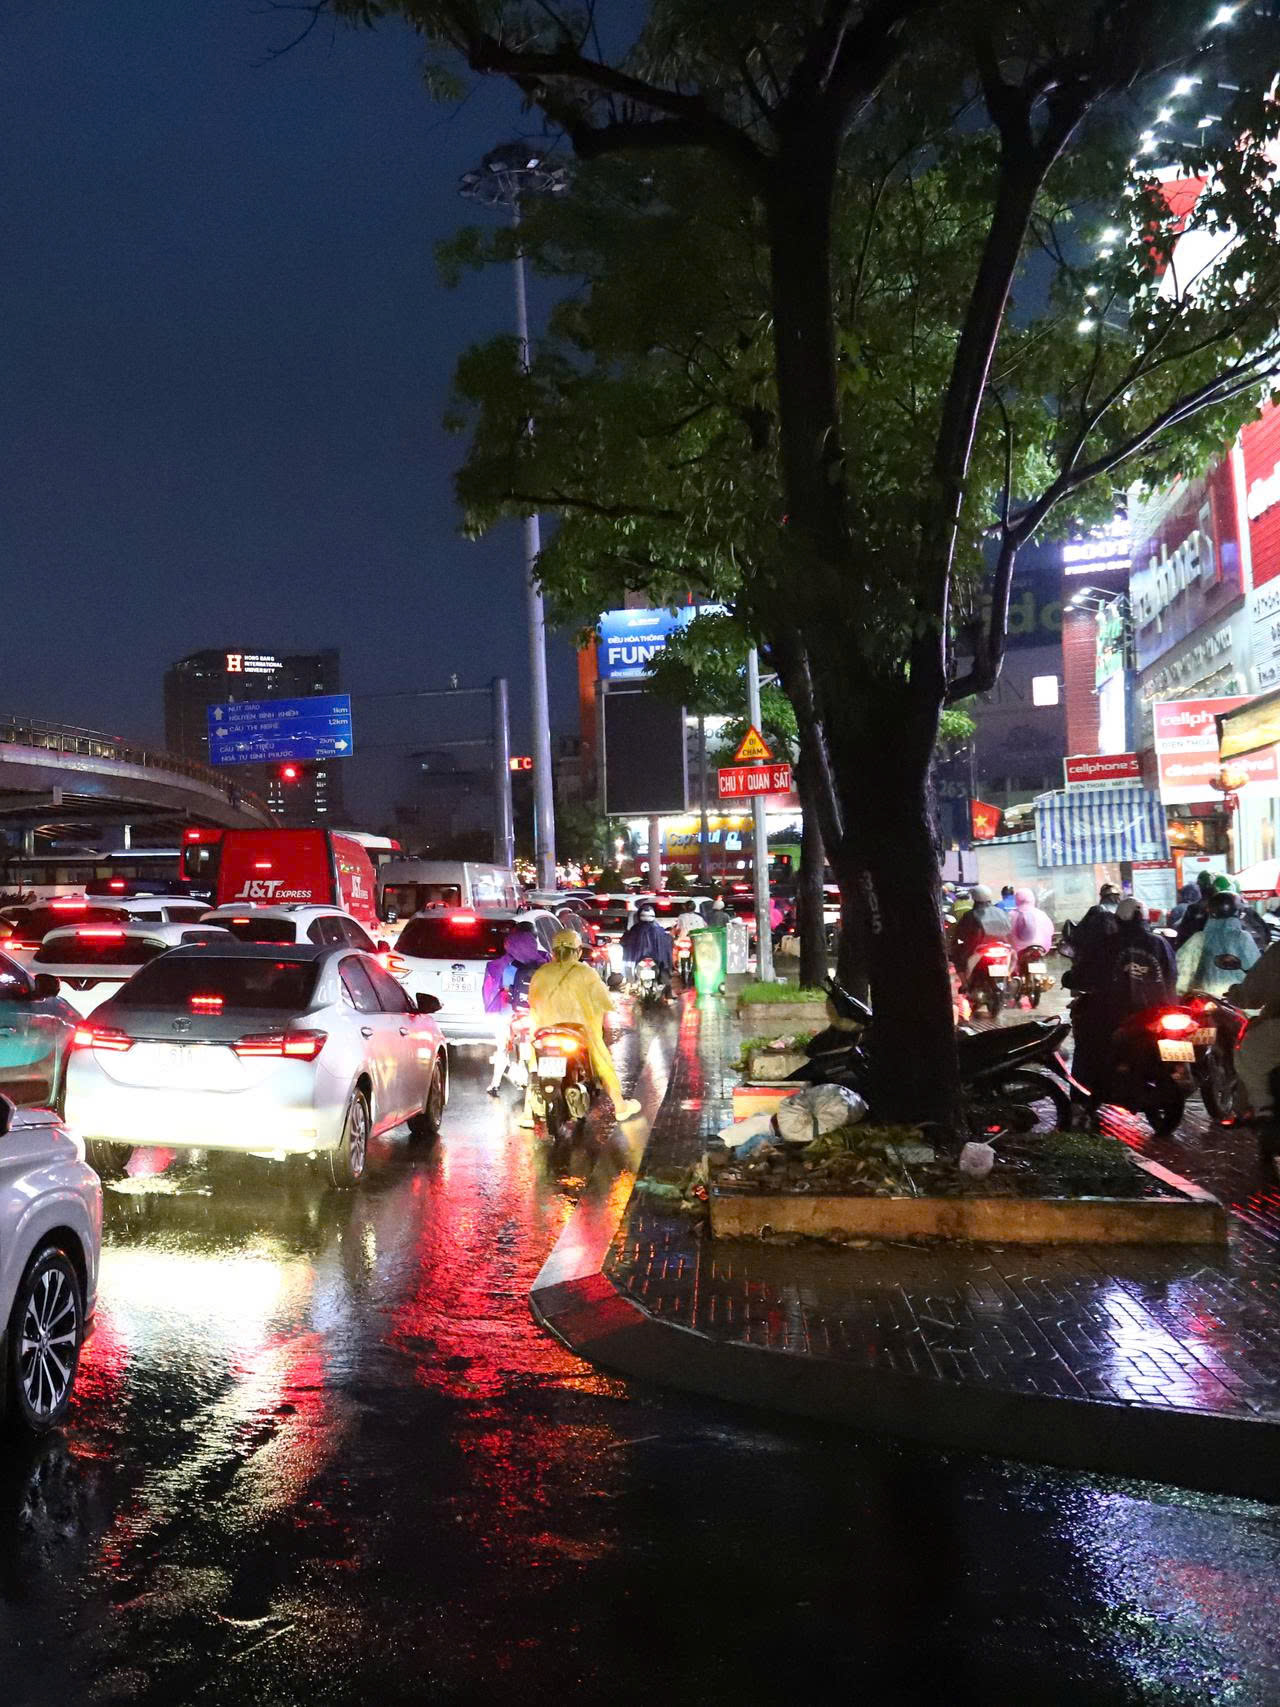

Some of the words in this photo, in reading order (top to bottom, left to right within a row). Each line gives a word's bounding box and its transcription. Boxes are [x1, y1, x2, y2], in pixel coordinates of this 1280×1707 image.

[720, 770, 736, 792] CHÚ
[738, 769, 744, 791] Ý
[747, 773, 770, 790] QUAN
[774, 767, 789, 788] SÁT
[235, 880, 284, 898] J&T
[275, 890, 312, 898] EXPRESS
